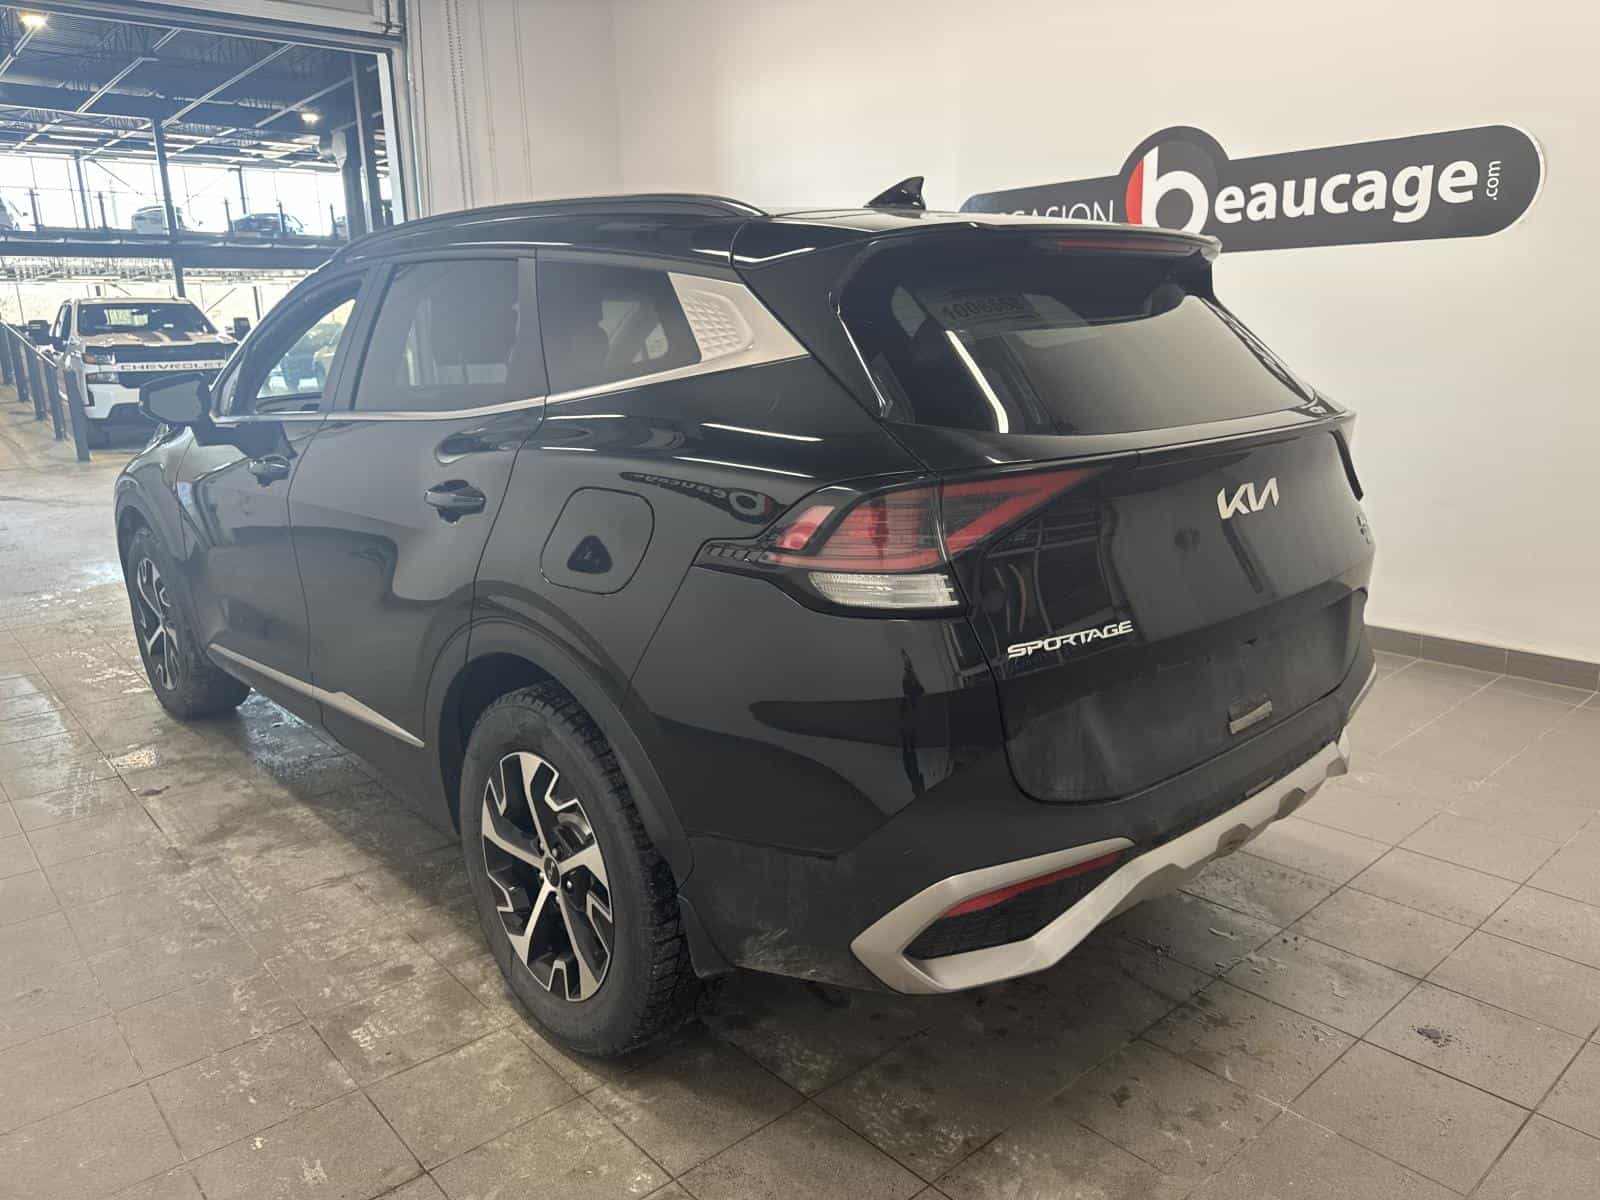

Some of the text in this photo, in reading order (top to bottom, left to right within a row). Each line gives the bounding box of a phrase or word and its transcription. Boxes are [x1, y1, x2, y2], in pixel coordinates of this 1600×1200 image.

[1141, 146, 1478, 234] beaucage
[119, 361, 224, 371] CHEVROLET
[1217, 477, 1279, 519] KIA
[1007, 620, 1133, 659] SPORTAGE
